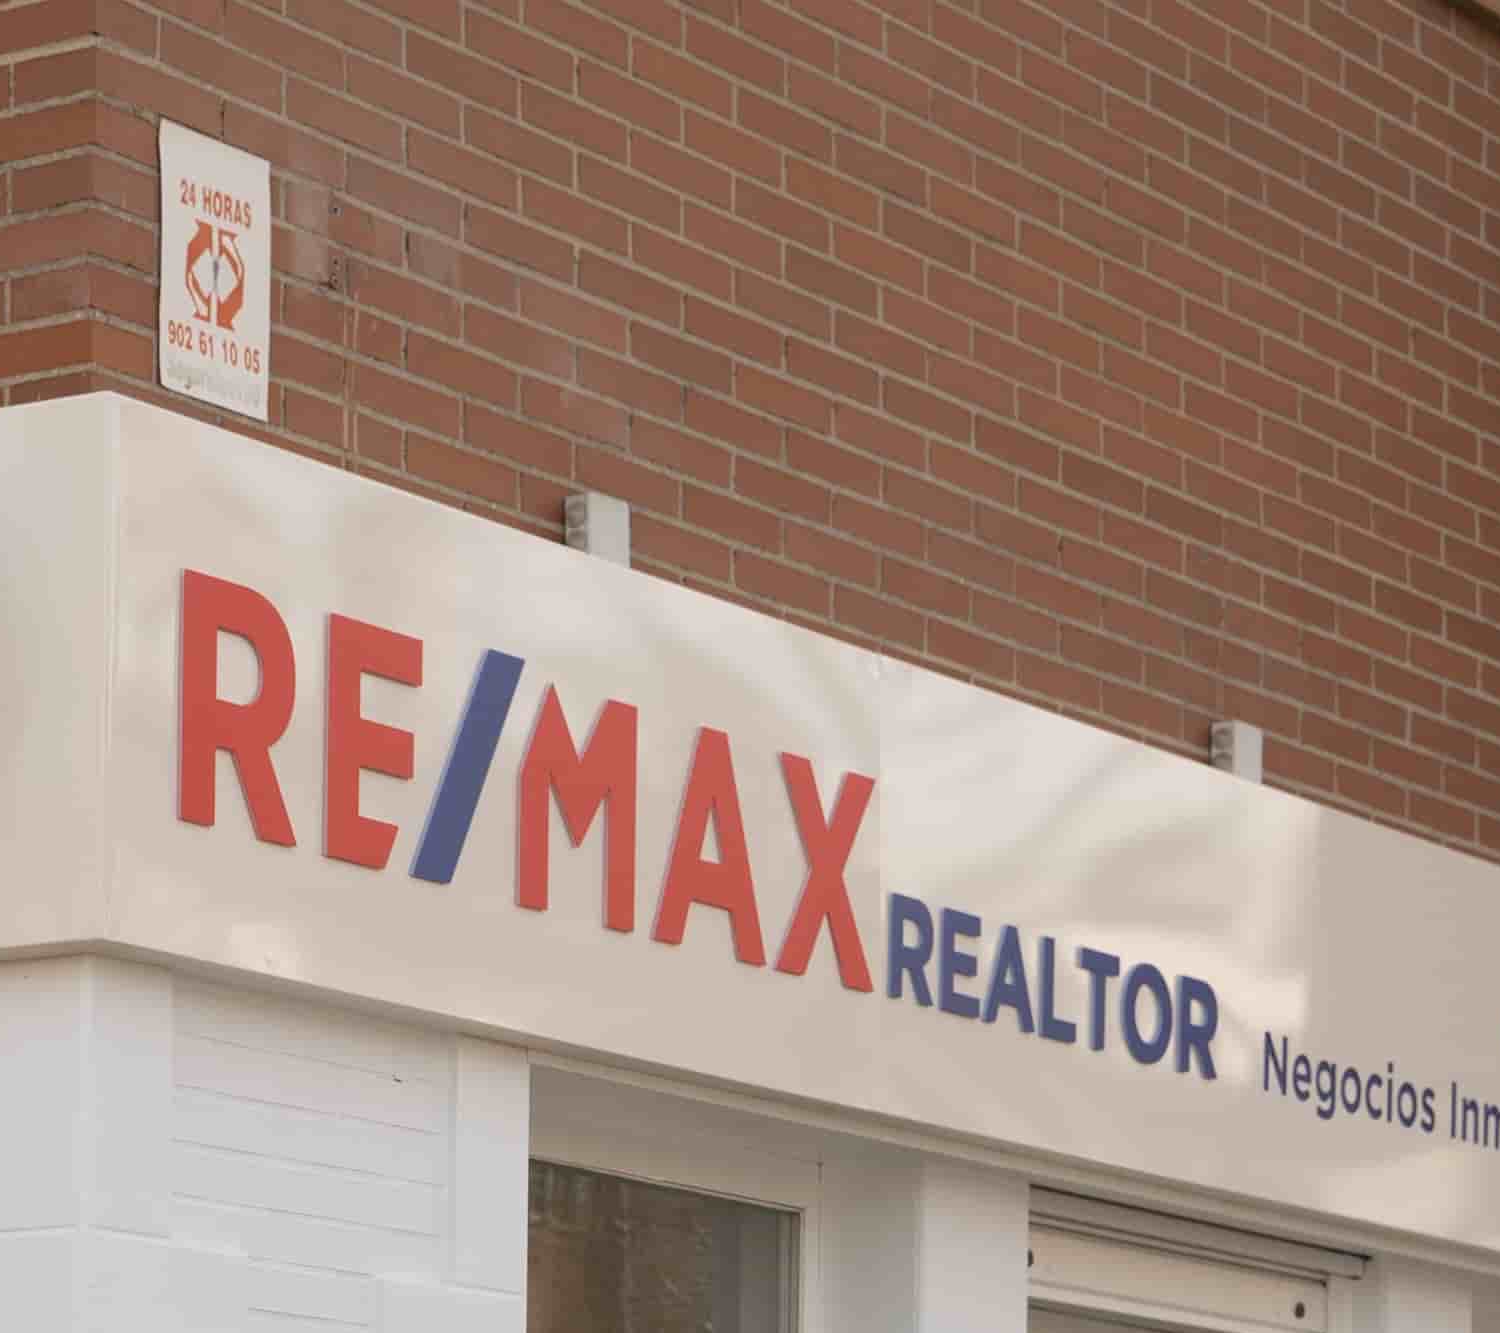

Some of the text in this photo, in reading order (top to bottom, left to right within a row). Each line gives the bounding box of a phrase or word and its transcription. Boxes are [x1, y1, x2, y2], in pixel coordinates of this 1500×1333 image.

[179, 178, 252, 229] 24 HORAS
[167, 319, 261, 374] 902 61 10 05
[176, 567, 1220, 1080] RE/MAX REALTOR
[1263, 1030, 1436, 1133] Negocios
